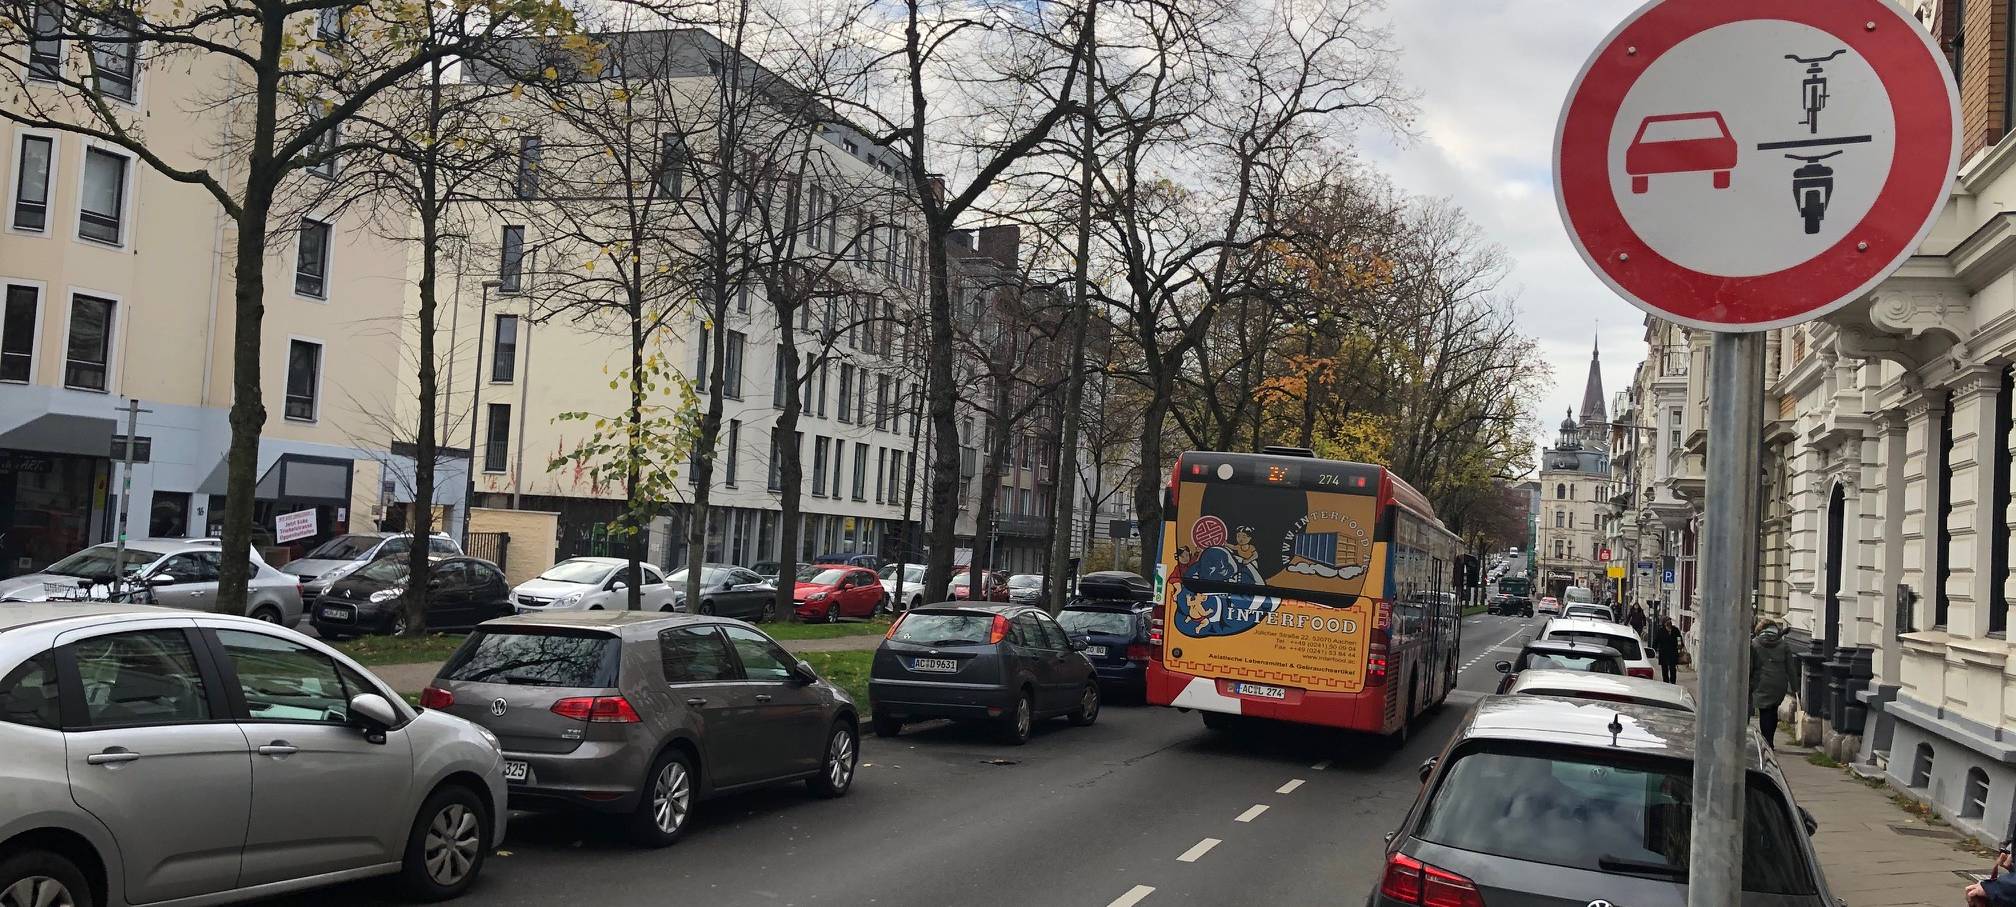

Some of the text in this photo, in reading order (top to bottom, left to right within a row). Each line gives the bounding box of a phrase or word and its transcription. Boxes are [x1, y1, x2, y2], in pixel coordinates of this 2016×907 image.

[1318, 474, 1340, 486] 274
[1665, 571, 1673, 582] P
[1227, 607, 1357, 634] INTERFOOD
[1208, 653, 1243, 662] Asiatische
[1244, 658, 1288, 668] Lebensmittel
[1296, 664, 1356, 676] Gebrauchsartikel
[1266, 687, 1282, 697] 274
[505, 762, 525, 776] 325
